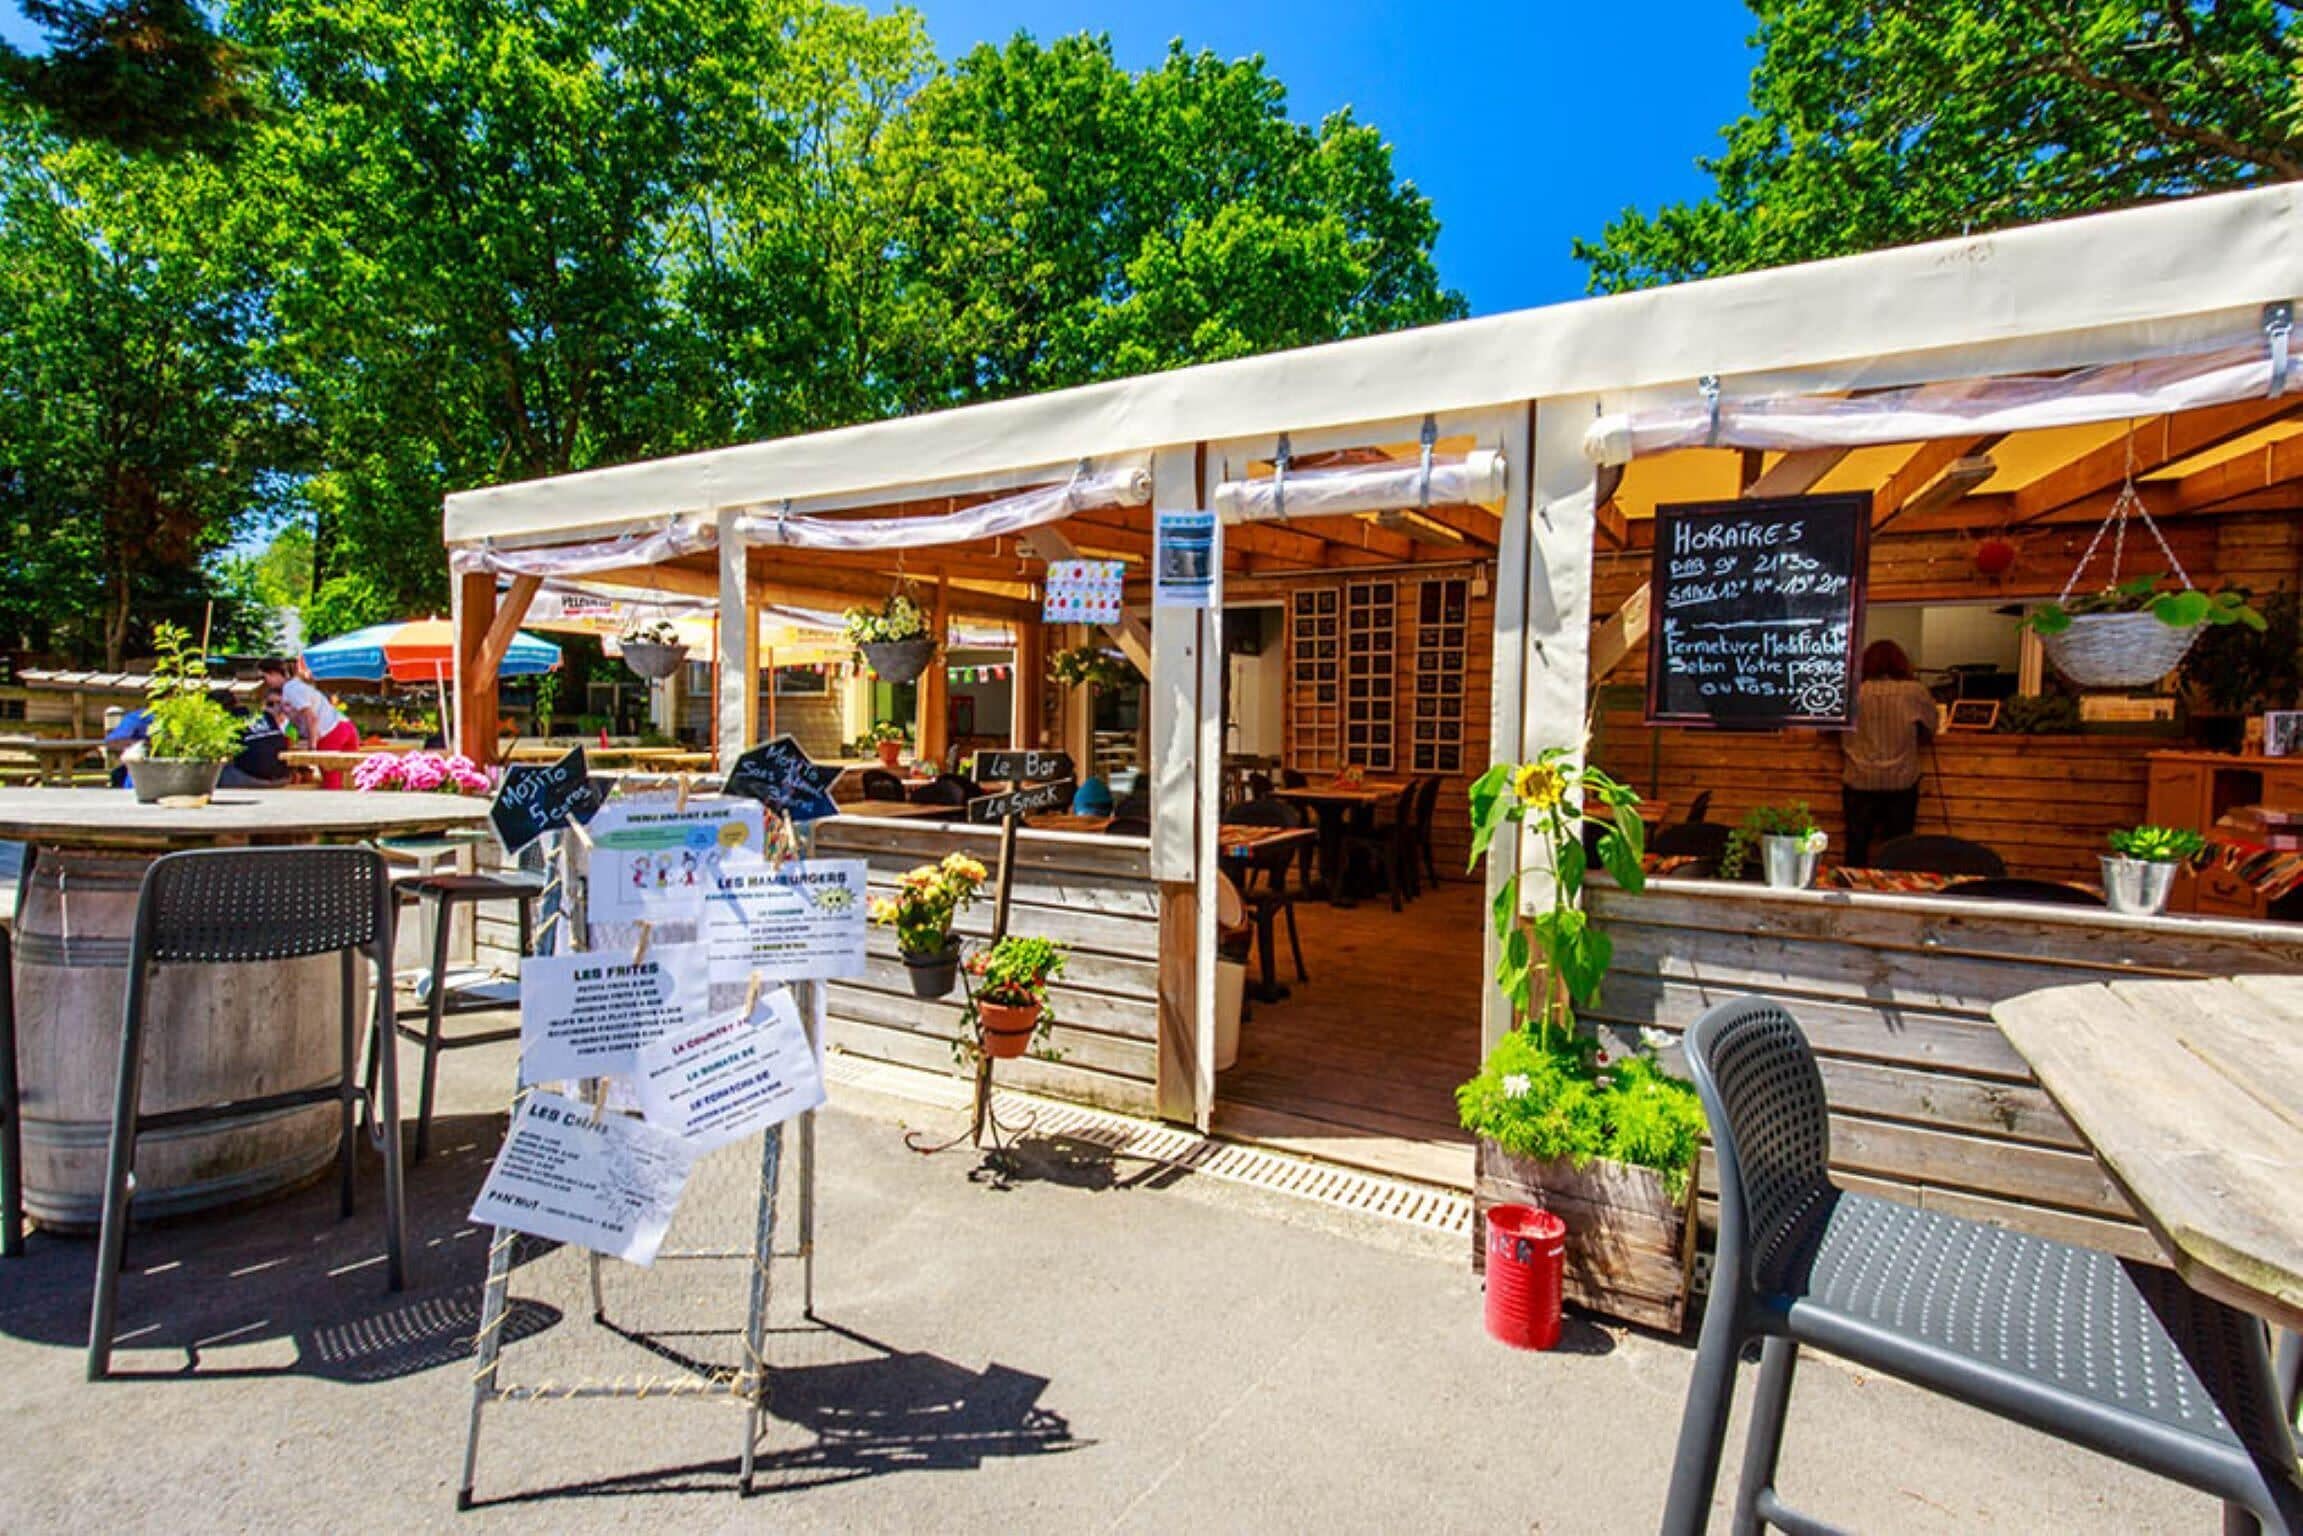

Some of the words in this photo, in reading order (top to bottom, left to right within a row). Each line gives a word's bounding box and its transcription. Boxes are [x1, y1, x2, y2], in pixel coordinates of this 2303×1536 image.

[990, 754, 1010, 776] Le
[1026, 751, 1057, 776] Bar
[1010, 784, 1059, 814] Snack
[717, 877, 745, 890] LES
[747, 871, 848, 888] HAMBURGERS
[573, 967, 603, 982] LES
[606, 961, 660, 980] FRITES
[528, 1103, 561, 1123] LES
